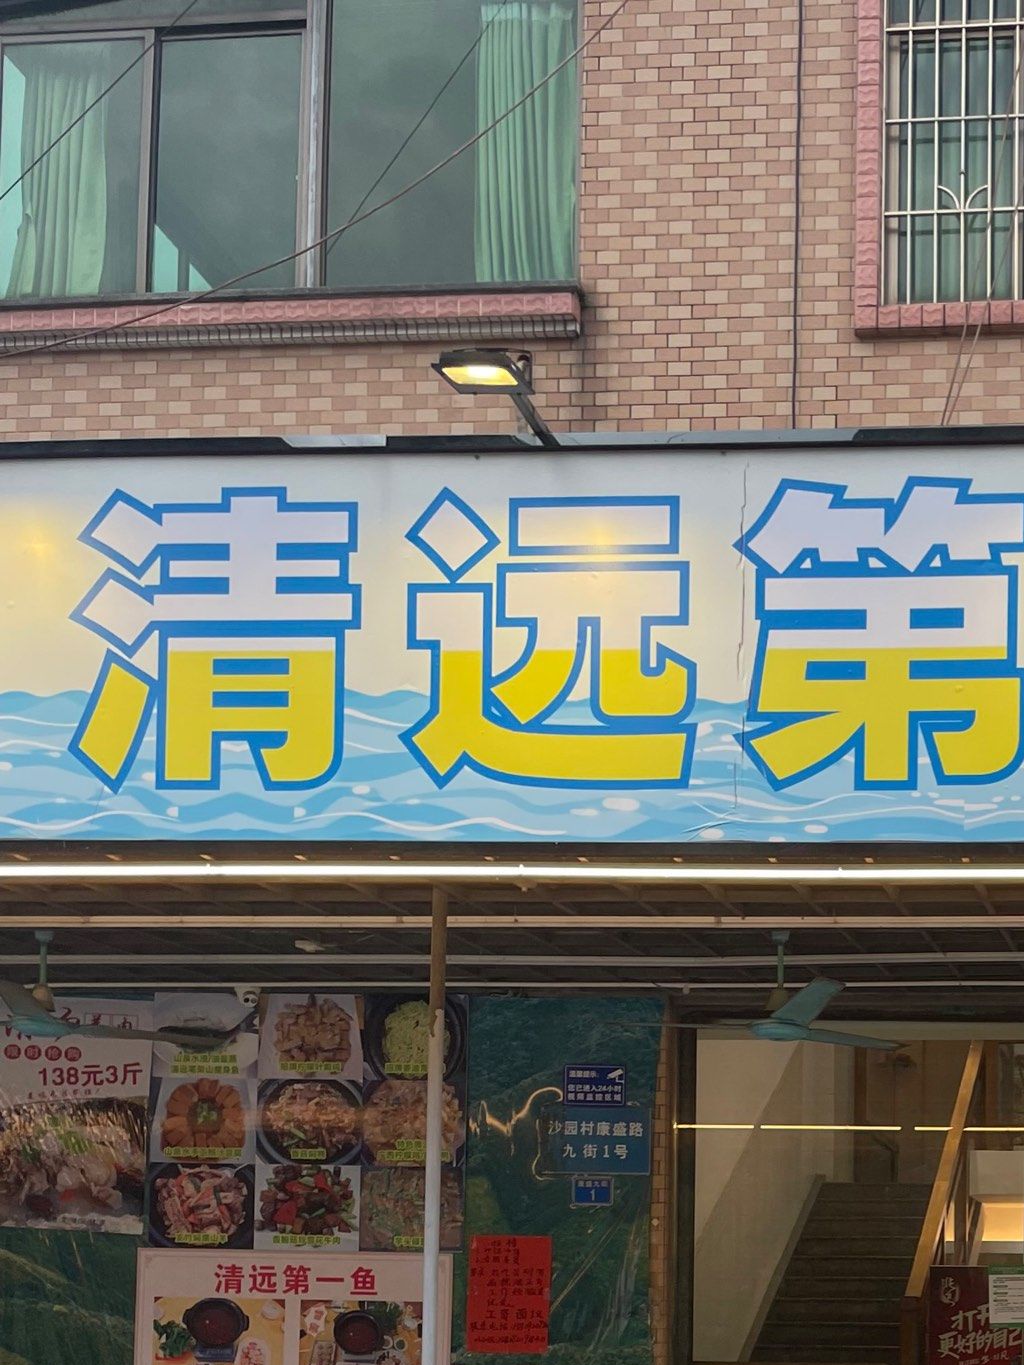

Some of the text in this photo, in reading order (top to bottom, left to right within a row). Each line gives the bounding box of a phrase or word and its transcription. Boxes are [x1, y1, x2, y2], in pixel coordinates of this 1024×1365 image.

[38, 1062, 143, 1086] 138元3斤
[548, 1121, 643, 1137] 沙园村康盛路
[563, 1144, 628, 1159] 九街1号
[214, 1264, 378, 1295] 清远第一鱼
